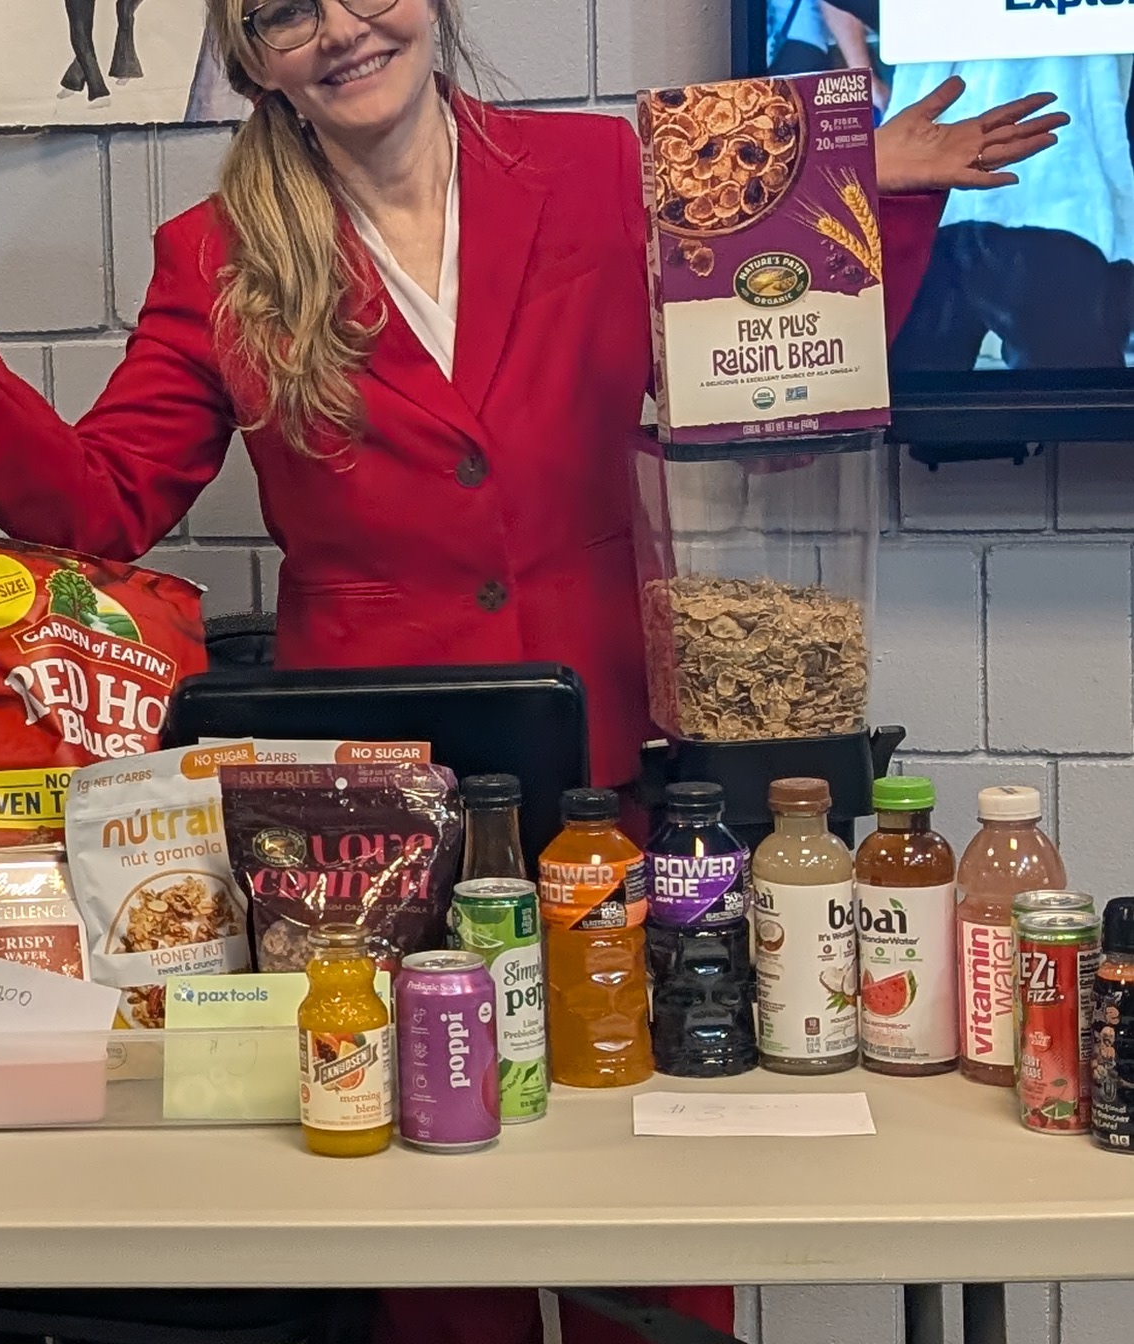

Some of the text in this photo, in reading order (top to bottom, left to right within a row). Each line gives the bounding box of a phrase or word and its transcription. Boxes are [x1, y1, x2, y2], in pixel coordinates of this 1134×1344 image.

[816, 74, 867, 95] ALWAYS
[813, 90, 869, 106] ORGANIC
[738, 257, 806, 281] NATURE'S PATH
[753, 292, 794, 305] ORGANIC
[780, 372, 806, 380] SOURCE
[22, 621, 173, 677] GARDEN of EATIN'
[3, 657, 170, 736] RED HO
[58, 709, 147, 759] Blues
[193, 749, 249, 767] NO SUGAR
[255, 747, 421, 764] CARBS NO SUGAR
[92, 774, 113, 788] NET
[115, 769, 153, 784] CARBS
[239, 770, 322, 785] BITE4BITE
[121, 840, 223, 870] nut granola
[539, 862, 614, 885] POWER
[654, 856, 736, 878] POWER
[539, 880, 575, 904] ADE
[654, 877, 700, 898] ADE
[828, 897, 855, 930] ba
[858, 898, 908, 935] bai
[4, 950, 48, 961] WAFER
[149, 942, 225, 967] HONEY NUT
[157, 958, 224, 976] sweet & crunchy
[503, 959, 544, 987] Simpl
[407, 979, 439, 992] Prebiotic
[965, 925, 995, 1057] vitamin
[522, 1018, 540, 1028] Lime
[439, 1010, 472, 1090] poppi
[339, 1090, 382, 1107] morning
